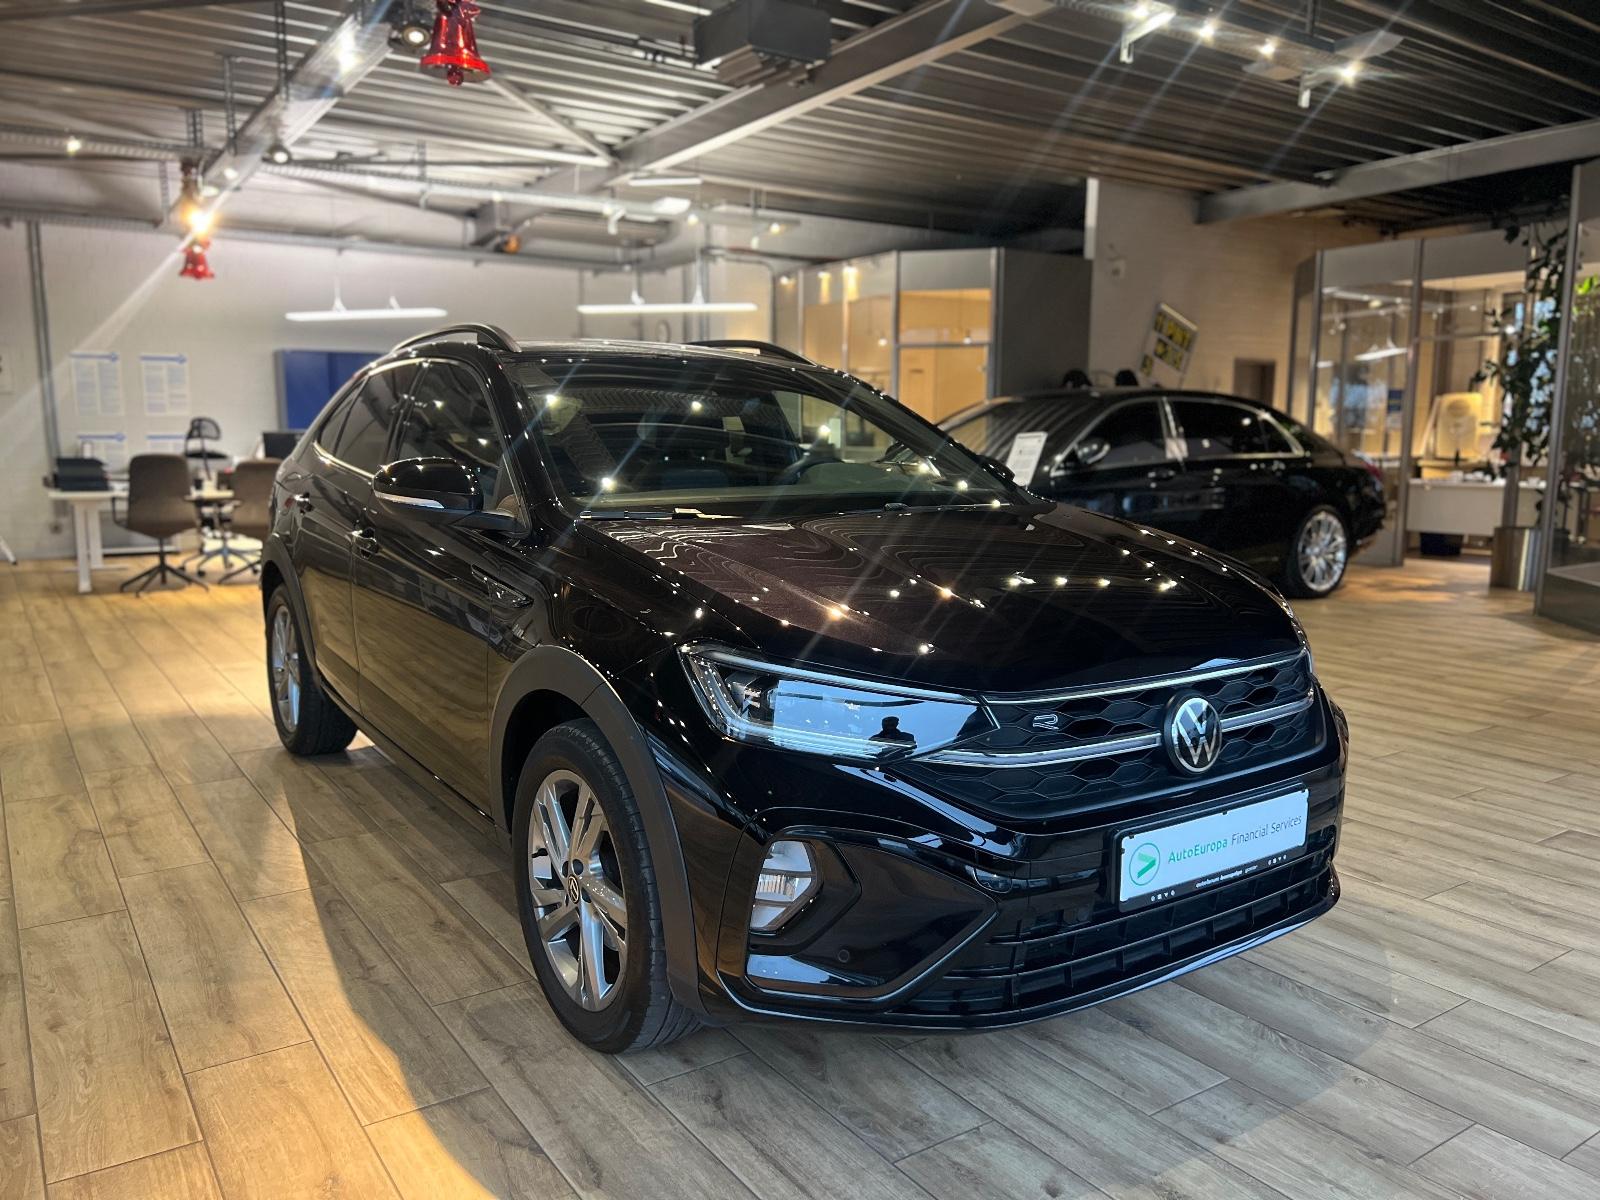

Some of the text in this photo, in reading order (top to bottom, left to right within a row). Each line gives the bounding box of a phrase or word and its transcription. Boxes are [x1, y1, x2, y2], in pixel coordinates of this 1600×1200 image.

[1168, 815, 1302, 864] AutoEuropa Financial Services
